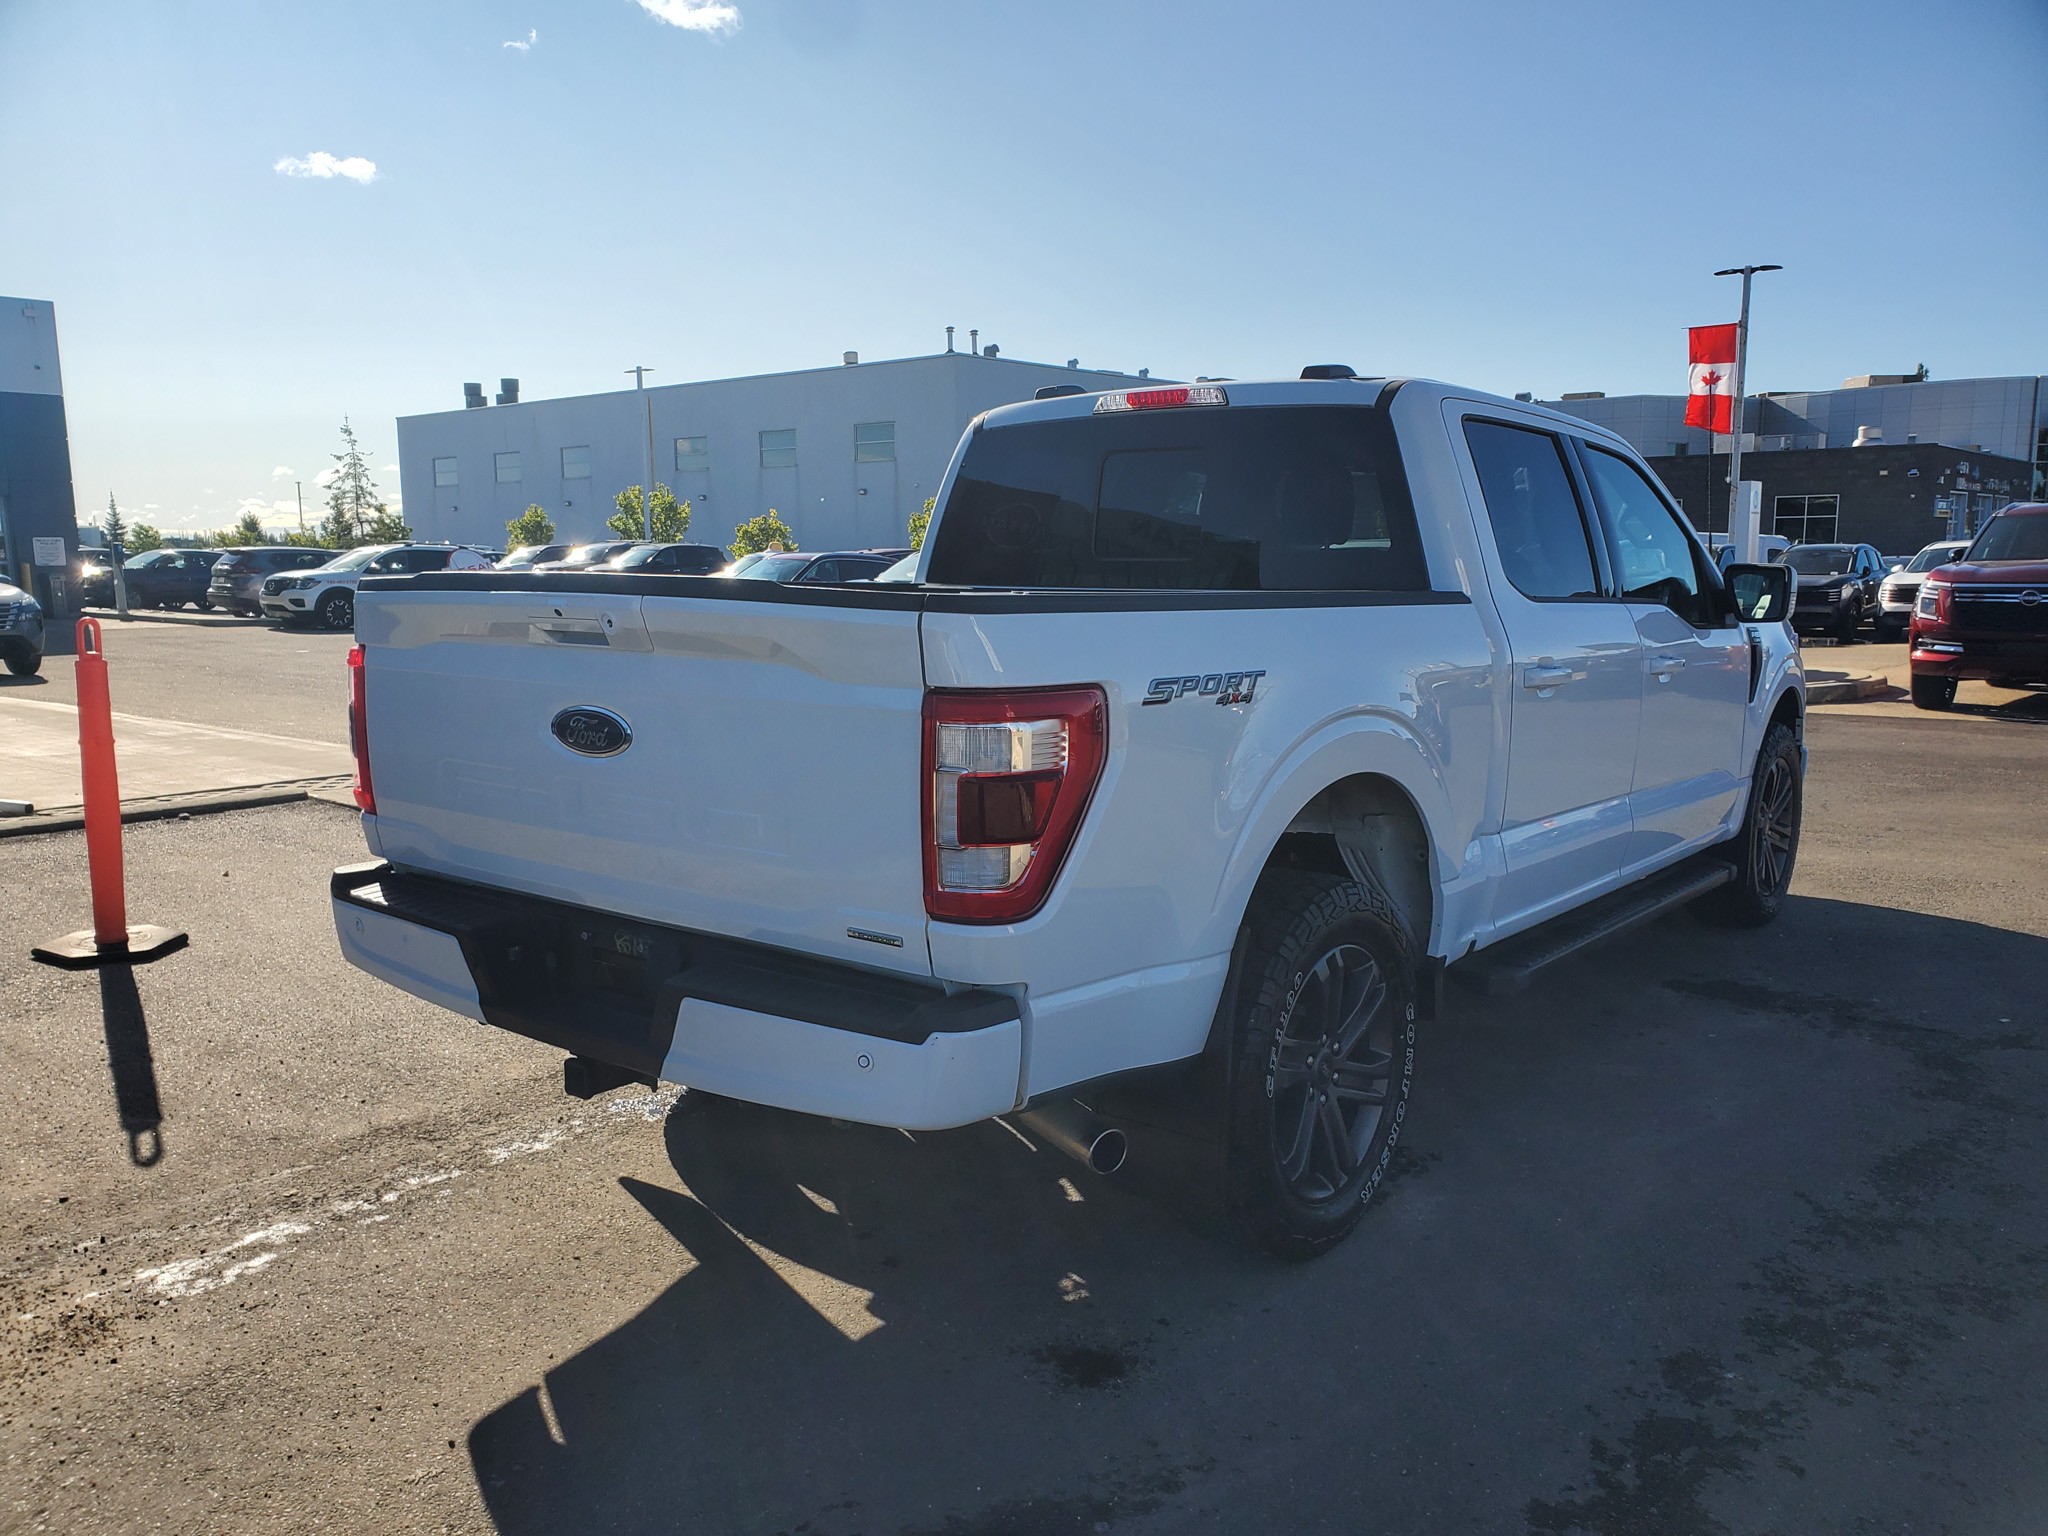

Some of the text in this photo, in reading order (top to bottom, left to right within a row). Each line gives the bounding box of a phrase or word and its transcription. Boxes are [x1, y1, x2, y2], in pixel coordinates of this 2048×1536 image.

[1142, 670, 1266, 706] SPORT
[566, 716, 609, 747] Ford
[1359, 1002, 1416, 1204] COMFORSER
